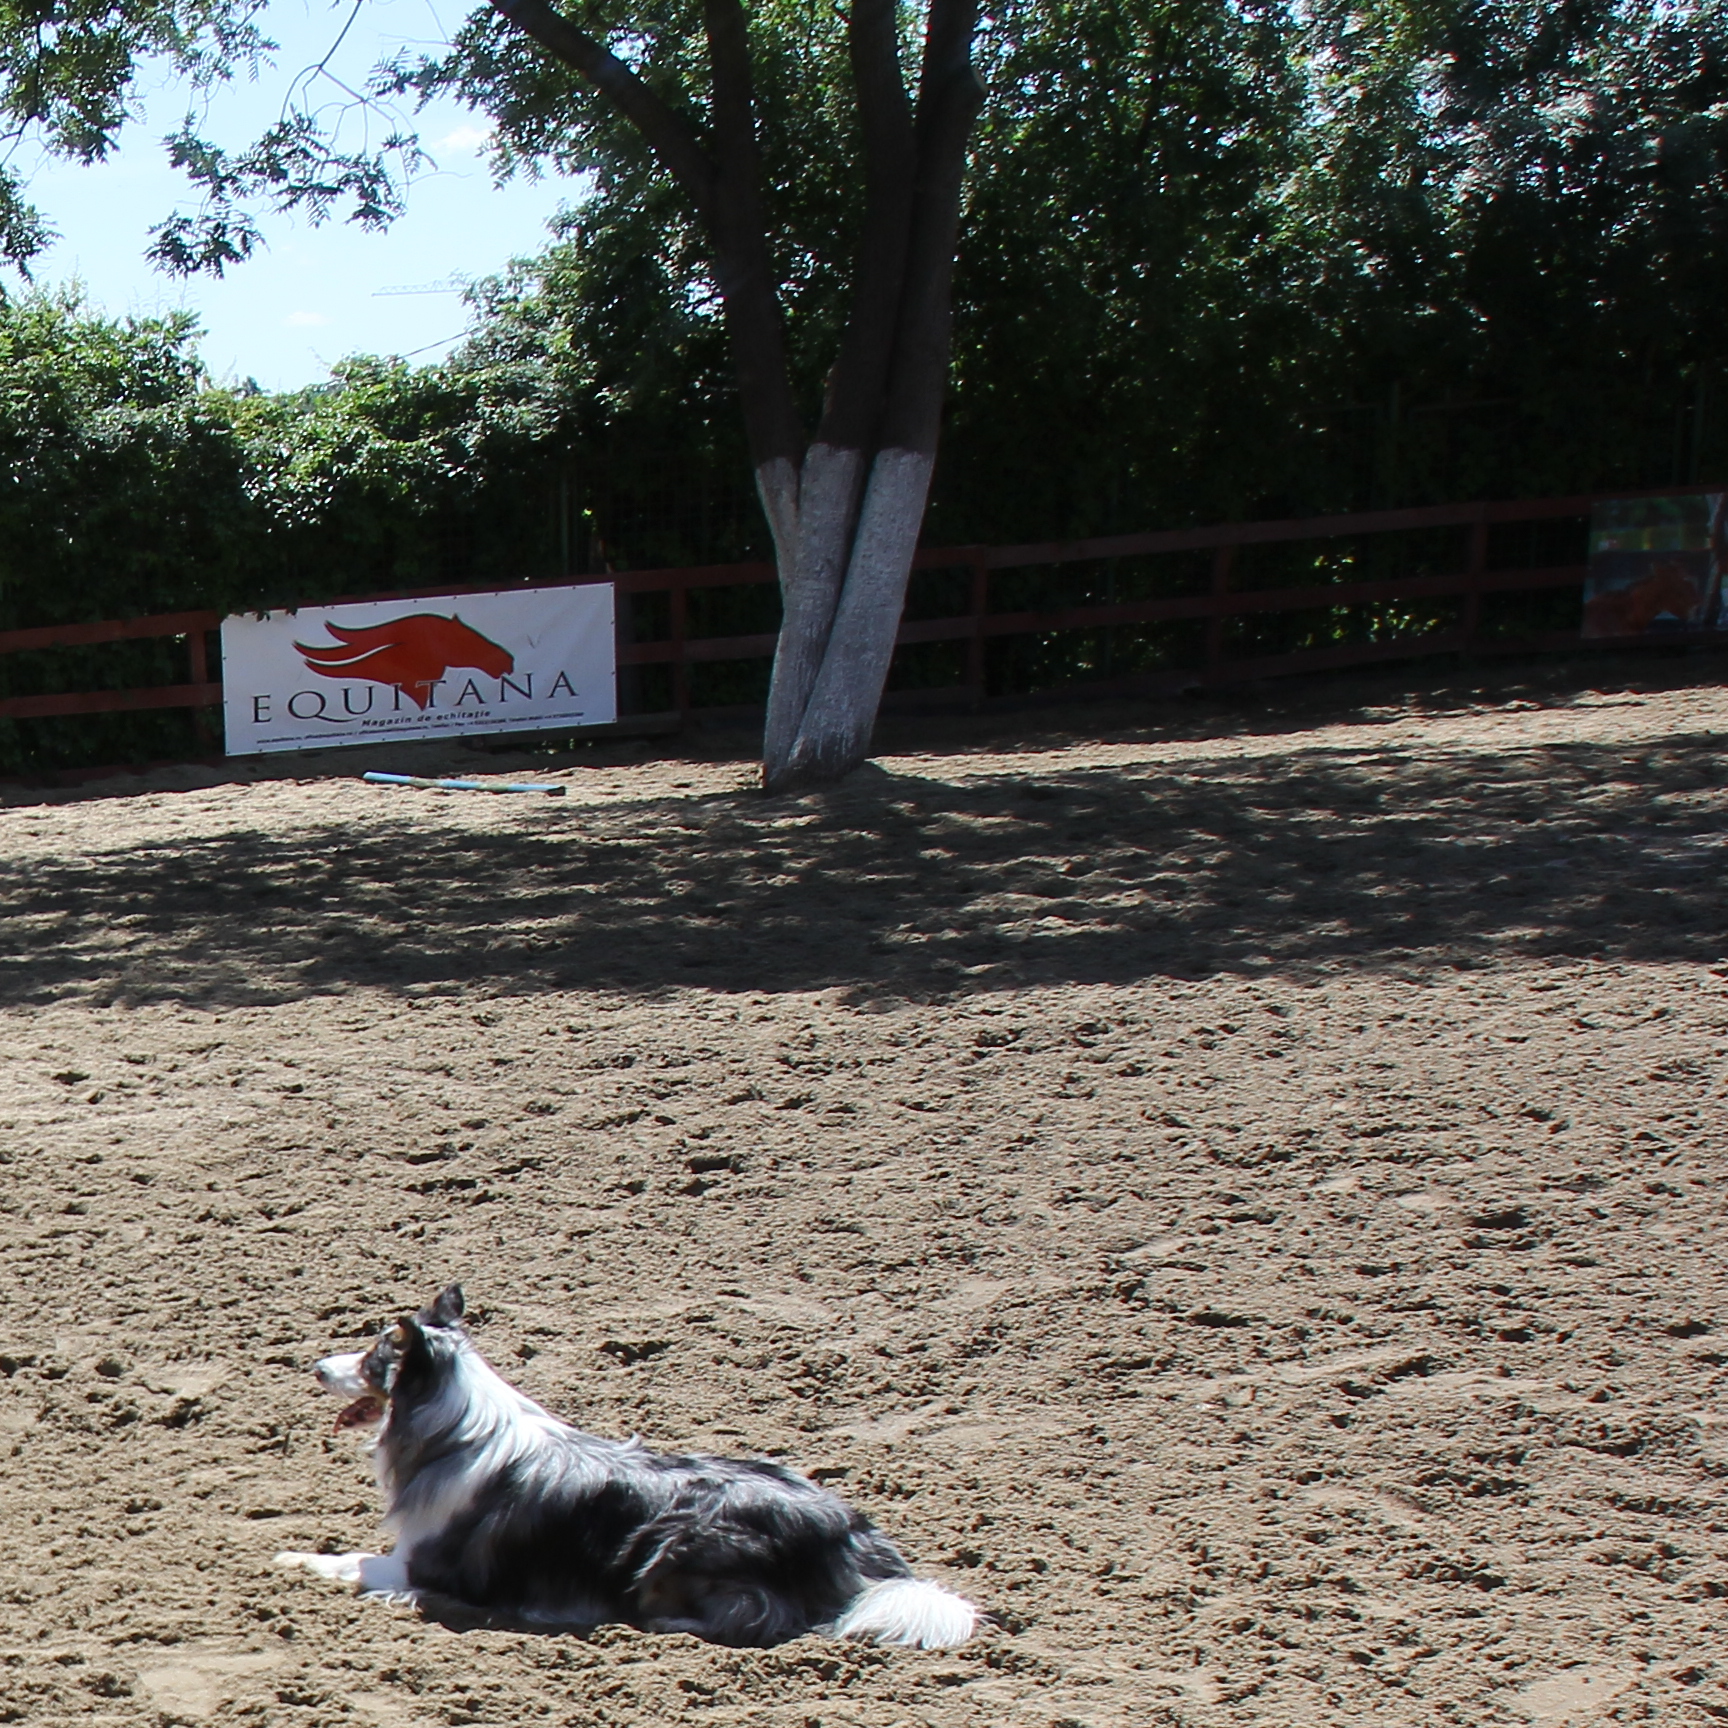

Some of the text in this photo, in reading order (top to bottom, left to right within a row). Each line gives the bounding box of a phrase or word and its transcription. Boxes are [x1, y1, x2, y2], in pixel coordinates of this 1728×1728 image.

[251, 669, 580, 724] EQUITANA
[361, 713, 413, 728] Magazin
[417, 711, 433, 723] de
